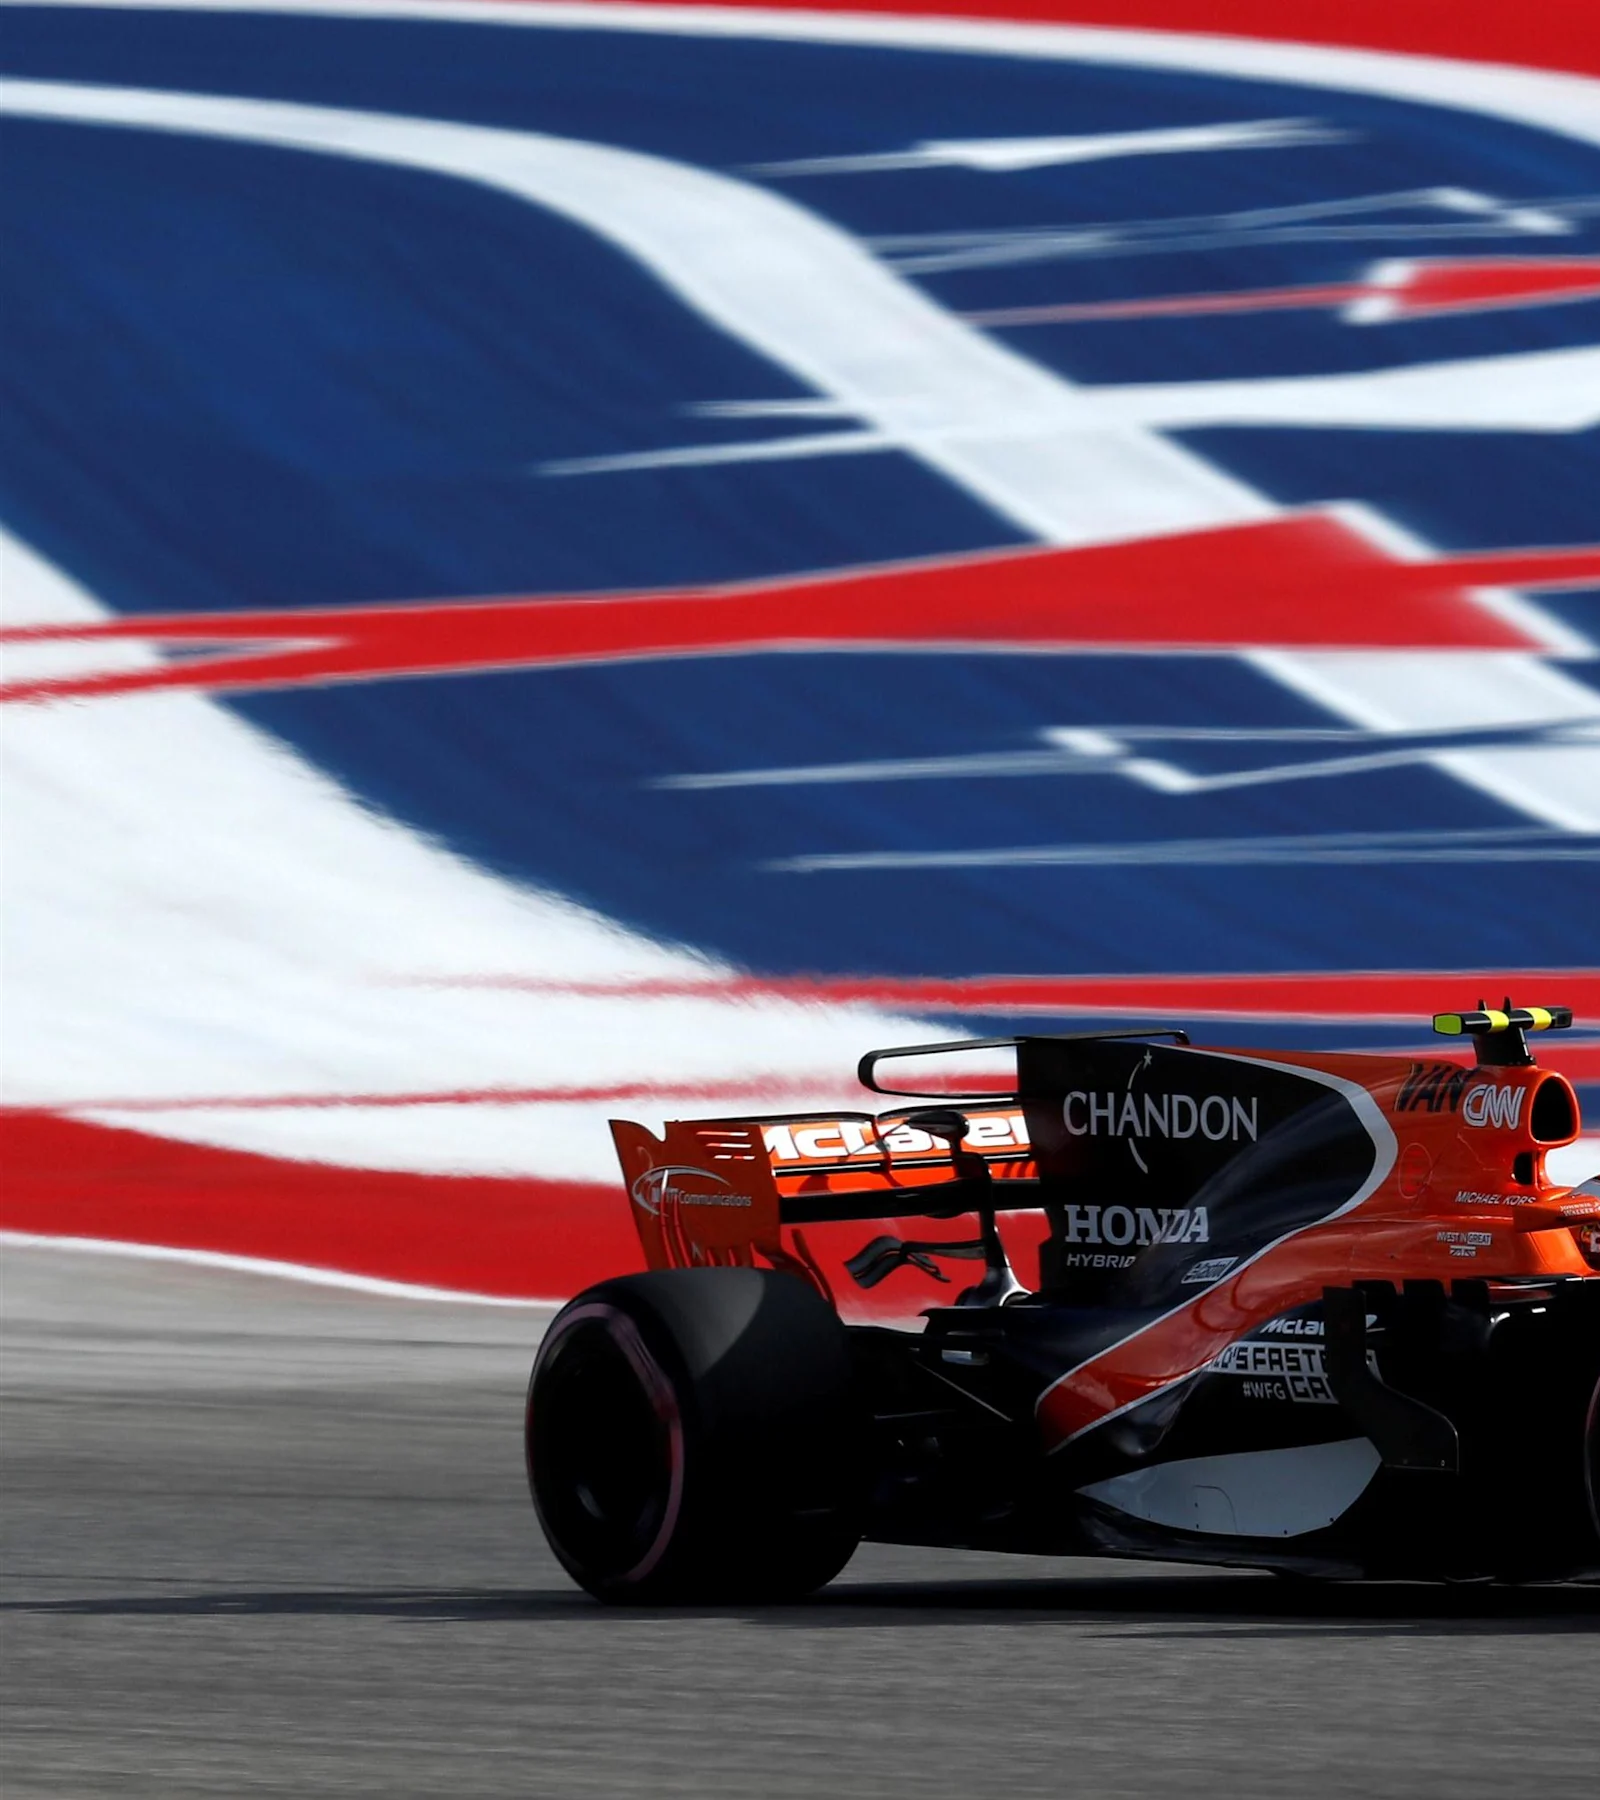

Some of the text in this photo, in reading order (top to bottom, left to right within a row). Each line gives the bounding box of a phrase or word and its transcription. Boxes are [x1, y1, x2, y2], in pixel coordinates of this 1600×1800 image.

[1463, 1084, 1526, 1130] CNN
[1063, 1091, 1258, 1142] CHANDON
[680, 1190, 752, 1207] Communications
[1455, 1191, 1499, 1205] MICHAEL
[1064, 1204, 1210, 1246] HONDA
[1468, 1233, 1491, 1245] GREAT
[1066, 1253, 1136, 1269] HYBRID
[1243, 1382, 1287, 1400] #WFG
